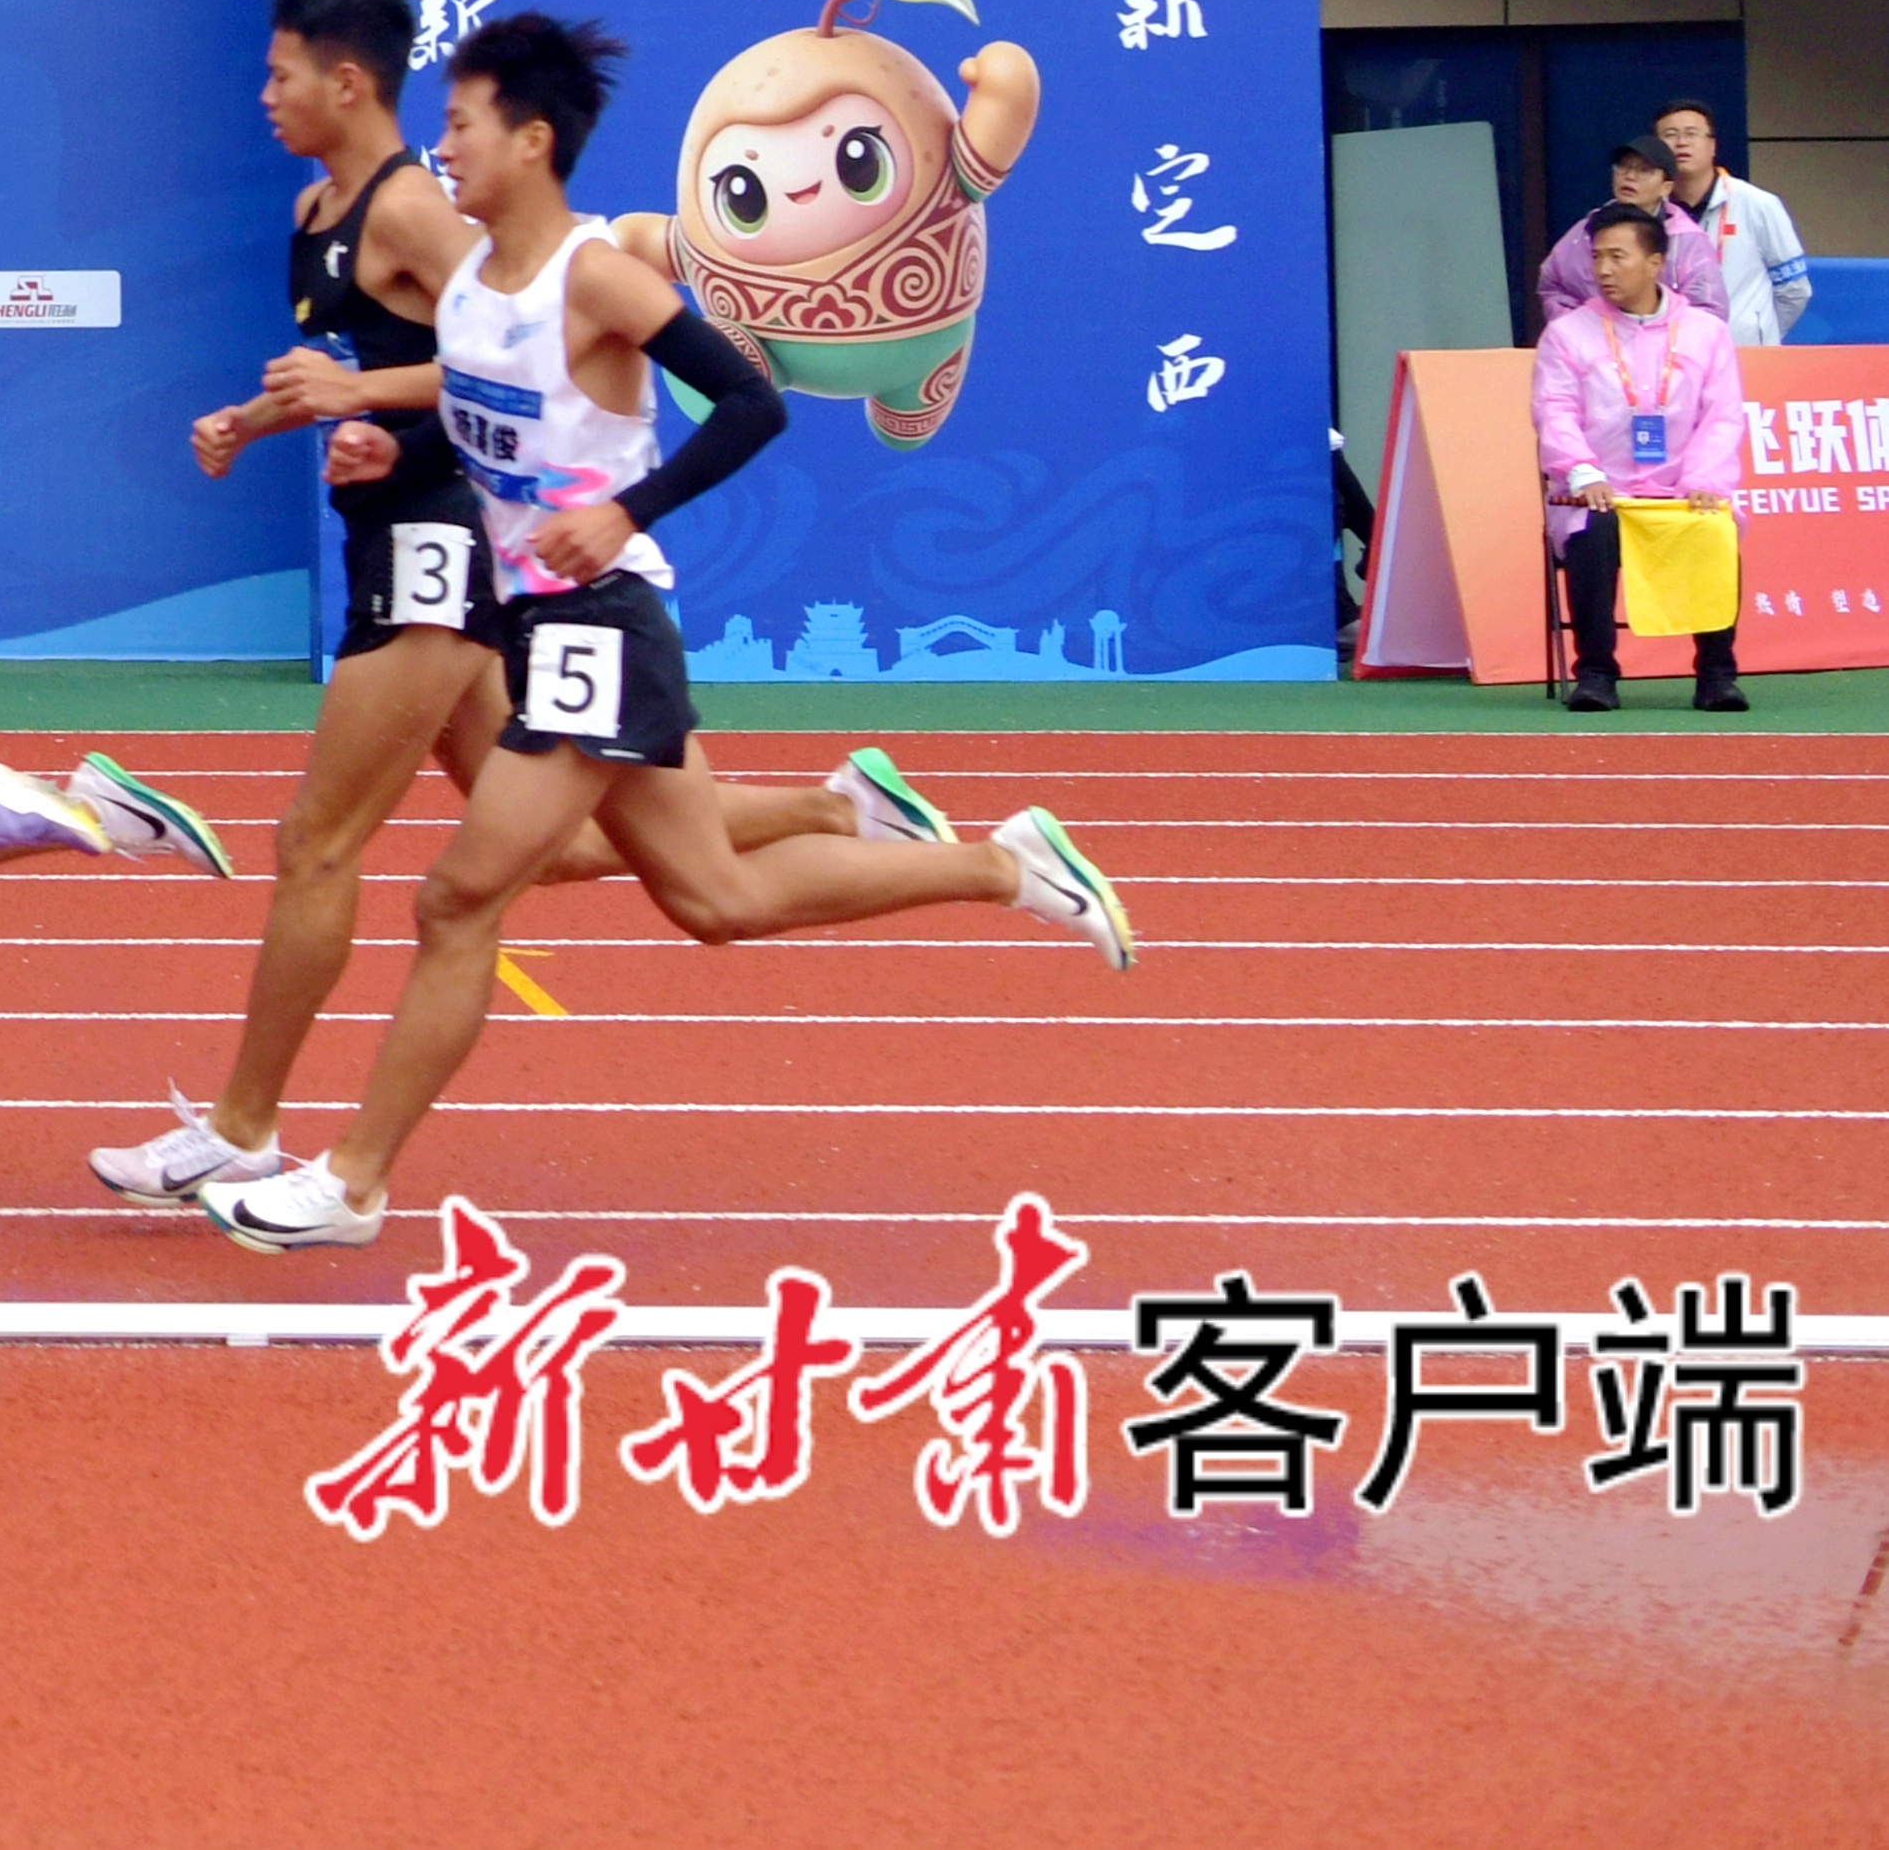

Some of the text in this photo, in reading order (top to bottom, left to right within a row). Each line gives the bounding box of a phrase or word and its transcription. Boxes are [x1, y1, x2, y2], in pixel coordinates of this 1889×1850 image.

[1732, 487, 1841, 514] FEIYUE
[411, 541, 449, 606] 3
[551, 645, 597, 714] 5
